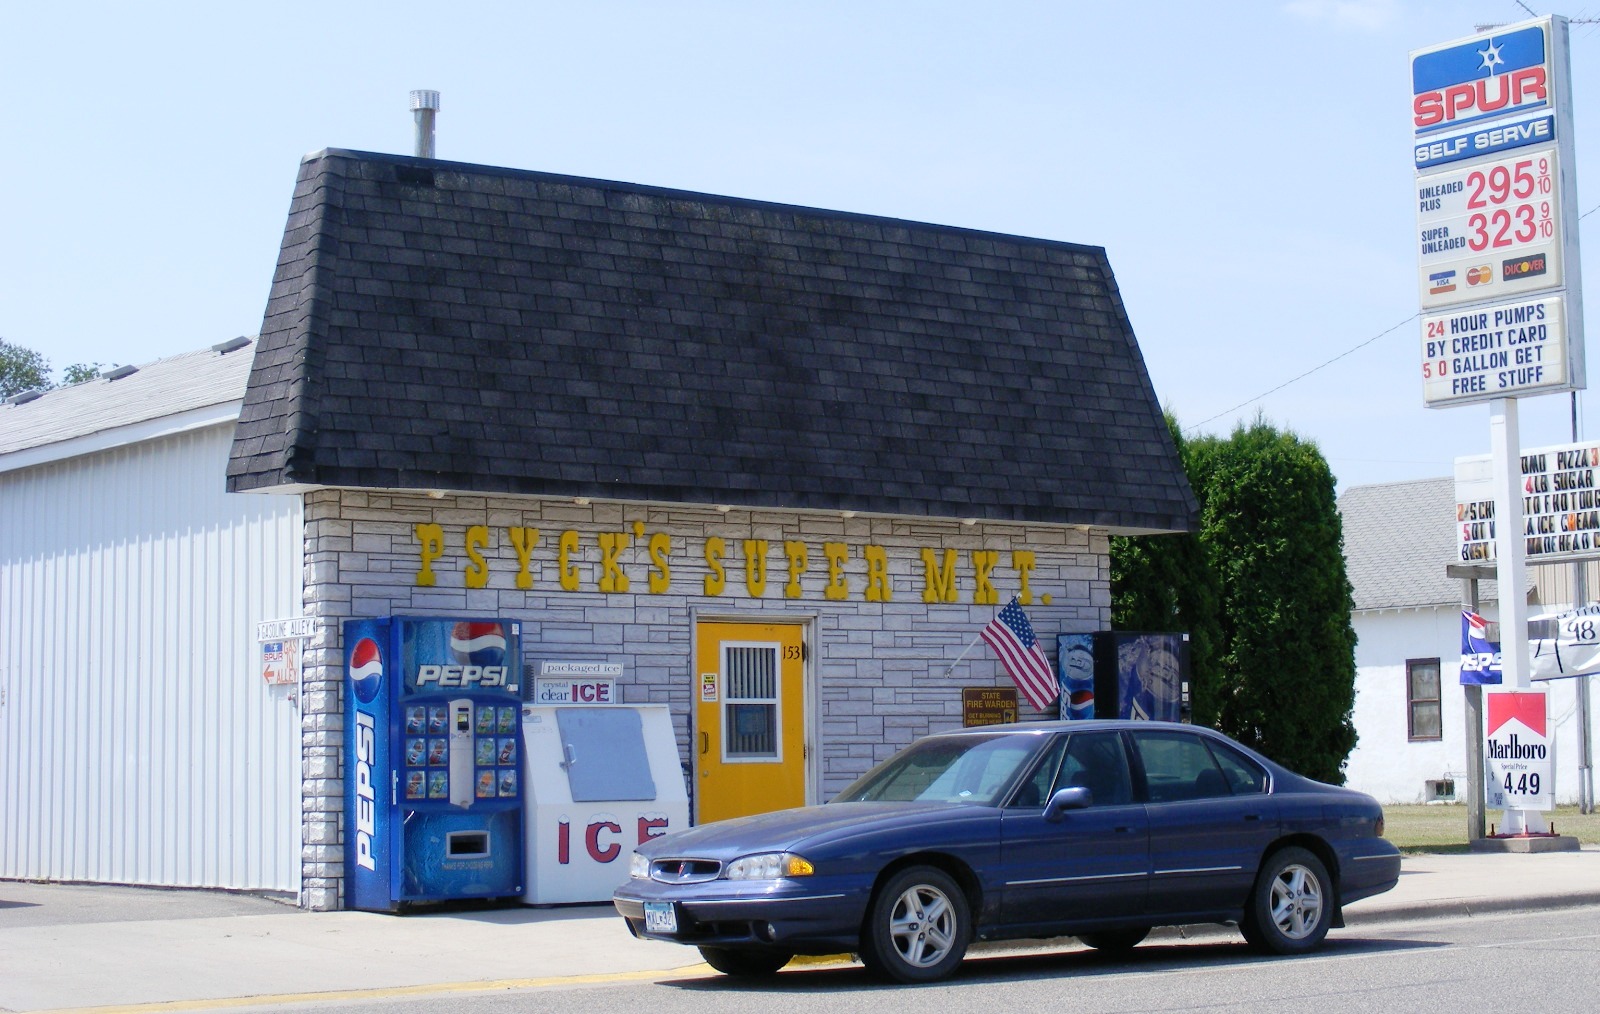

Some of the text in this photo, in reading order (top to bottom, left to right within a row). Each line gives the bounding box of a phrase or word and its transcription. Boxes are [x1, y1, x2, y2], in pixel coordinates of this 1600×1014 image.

[1413, 66, 1547, 127] SPUR
[1415, 119, 1549, 163] SELF SERVE
[1420, 181, 1463, 200] UNLEADED
[1466, 160, 1535, 210] 295
[1420, 198, 1441, 213] PLUS
[1421, 226, 1449, 242] SUPER
[1468, 204, 1537, 251] 323
[1422, 236, 1466, 255] UNLEADED
[1504, 259, 1544, 276] DISCOVER
[1436, 278, 1450, 287] VISA
[1427, 303, 1545, 338] 24 HOUR PUMPS
[1427, 324, 1547, 358] BY CREDIT CARD
[1453, 351, 1508, 374] GALLON
[1515, 345, 1543, 365] GET
[1452, 365, 1543, 395] FREE STUFF
[1557, 449, 1588, 470] PIZZA
[1553, 470, 1593, 491] SUGAR
[1537, 515, 1555, 534] ICE
[1560, 511, 1600, 532] CREAM
[416, 520, 1053, 606] PSYCK'S SUPER MKT.
[261, 619, 310, 639] GASOLINE ALLEY
[264, 652, 283, 661] SPUR
[284, 640, 297, 654] GAS
[783, 646, 800, 660] 153
[276, 668, 297, 683] ALLEY
[416, 664, 509, 687] PEPSI
[546, 663, 620, 674] packaged ice
[541, 682, 610, 702] clear ICE
[542, 681, 569, 689] crystal
[966, 700, 1016, 708] FIRE WARDEN
[1487, 733, 1547, 760] Marlboro
[356, 711, 376, 871] PEPSI
[1504, 772, 1540, 795] 4.49
